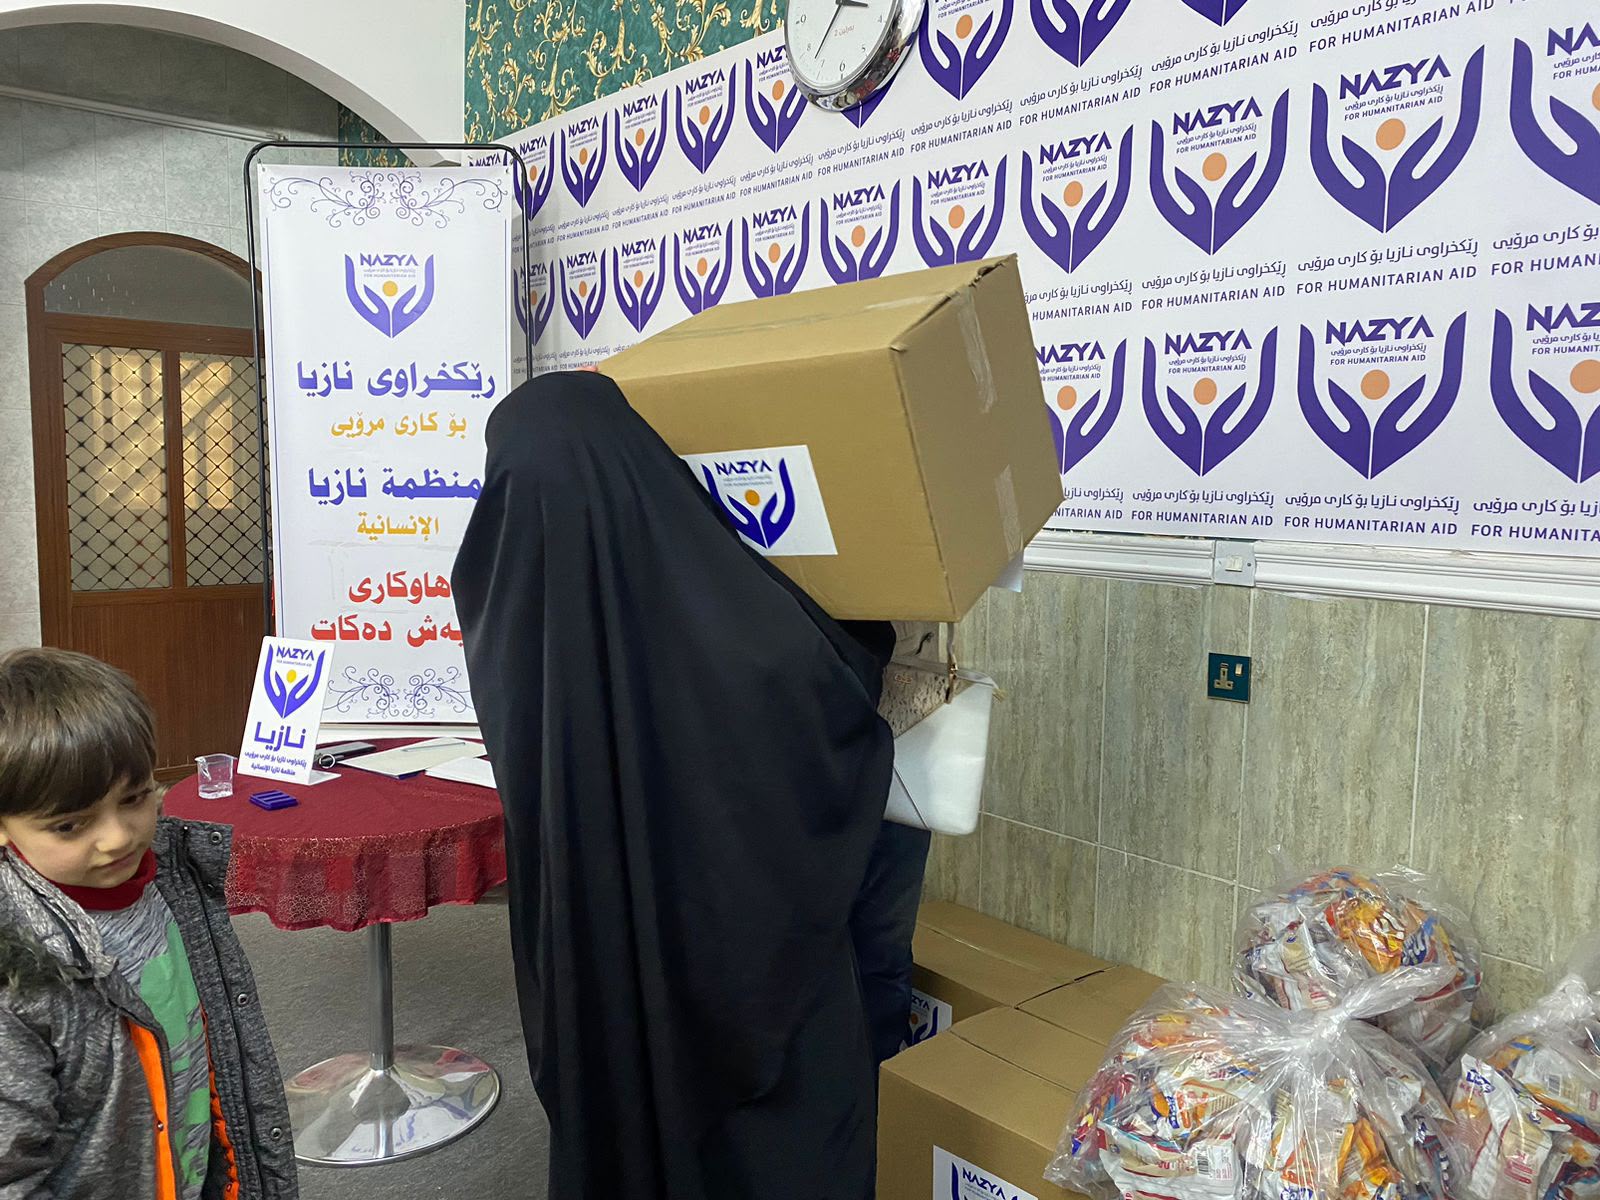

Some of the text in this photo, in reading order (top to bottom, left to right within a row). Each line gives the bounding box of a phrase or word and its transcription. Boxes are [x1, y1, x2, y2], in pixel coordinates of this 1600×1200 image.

[1310, 0, 1494, 52] FOR HUMANITARIAN AID
[757, 45, 786, 68] NAZ
[1150, 46, 1296, 92] FOR HUMANITARIAN AID
[1340, 55, 1451, 100] NAZYA
[686, 68, 725, 94] NAZYA
[624, 94, 658, 117] NAZYA
[1020, 87, 1140, 126] FOR HUMANITARIAN AID
[1173, 96, 1262, 135] NAZYA
[1345, 93, 1442, 121] FOR HUMANITARIAN AID
[569, 116, 599, 137] NAZYA
[911, 120, 1012, 152] FOR HUMANITARIAN AID
[520, 136, 546, 155] NAZYA
[1040, 131, 1112, 164] NAZYA
[818, 147, 904, 176] FOR HUMANITARIAN AID
[928, 160, 989, 189] NAZYA
[834, 184, 885, 210] NAZYA
[753, 205, 797, 228] NAZYA
[684, 223, 722, 244] NAZYA
[622, 238, 656, 256] NAZYA
[360, 252, 418, 266] NAZYA
[567, 251, 597, 268] NAZYA
[1492, 253, 1600, 275] FOR HUMAN
[1297, 266, 1476, 294] FOR HUMANITARIAN AID
[1142, 286, 1284, 310] FOR HUMANITARIAN AID
[1033, 302, 1131, 320] HUMANITARIAN AID
[1526, 302, 1600, 334] NAZ
[1326, 315, 1434, 346] NAZYA
[1034, 340, 1106, 366] NAZYA
[1165, 329, 1252, 357] NAZYA
[1348, 356, 1408, 364] HUMANITARIAN
[1411, 352, 1426, 361] AID
[714, 460, 773, 476] NAZYA
[1054, 507, 1122, 519] NITARIAN AID
[1132, 511, 1272, 526] FOR HUMANITARIAN AID
[1285, 516, 1457, 534] FOR HUMANITARIAN AID
[1472, 524, 1600, 542] FOR HUMANITA
[276, 645, 314, 661] NAZYA
[912, 994, 930, 1009] ZYA
[962, 1168, 1006, 1200] NAZYA
